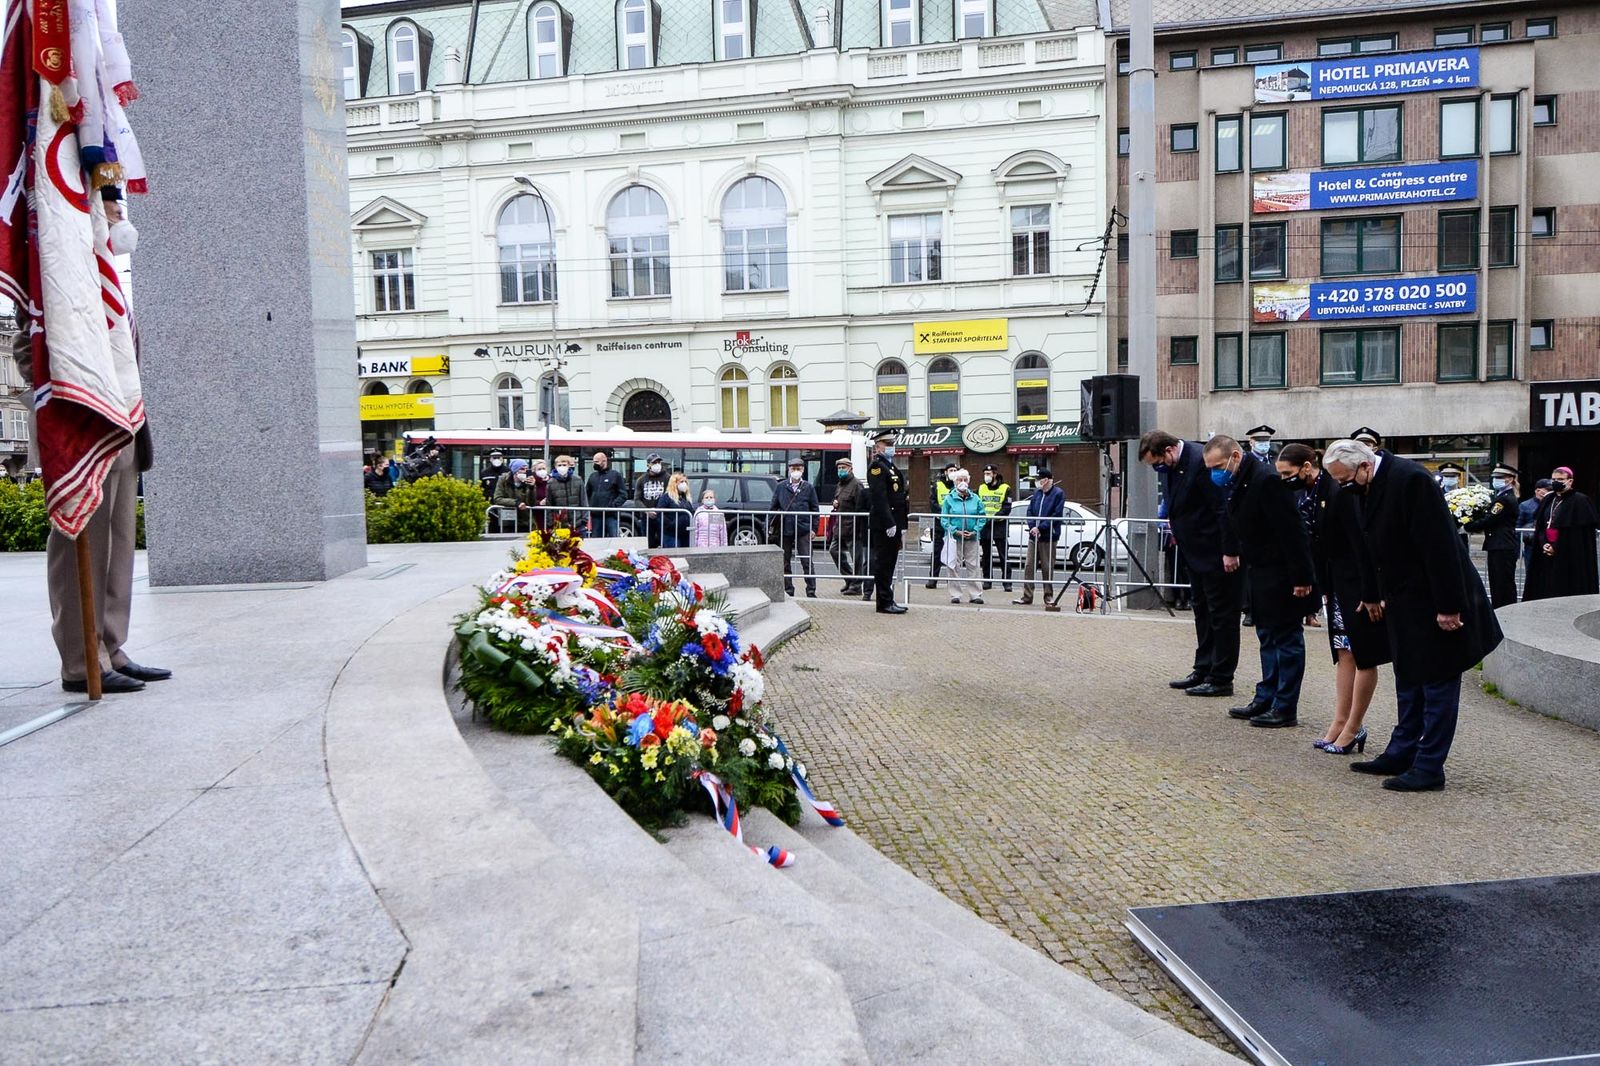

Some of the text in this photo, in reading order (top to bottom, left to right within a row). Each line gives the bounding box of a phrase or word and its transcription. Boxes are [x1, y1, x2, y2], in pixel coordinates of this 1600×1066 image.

[1319, 57, 1470, 81] HOTEL PRIMAVERA
[1319, 82, 1377, 94] NEPOMUCKÁ
[1380, 82, 1398, 90] 128,
[1401, 77, 1430, 88] PLZEŇ
[1455, 75, 1470, 83] km
[1318, 172, 1468, 191] Hotel & Congress centre
[1330, 188, 1456, 203] WWW.PRIMAVERAHOTEL.CZ
[1317, 283, 1467, 303] +420 378 020 500
[1317, 300, 1466, 314] UBYTOVÁNÍ KONFERENCE SVATBY
[596, 341, 682, 351] Raiffeisen centrum
[724, 335, 760, 351] Broker
[963, 335, 1003, 343] SPOŘITELNA
[493, 343, 561, 357] TAURUM
[732, 341, 789, 358] Consulting
[371, 361, 408, 374] BANK
[1540, 392, 1600, 427] TAB
